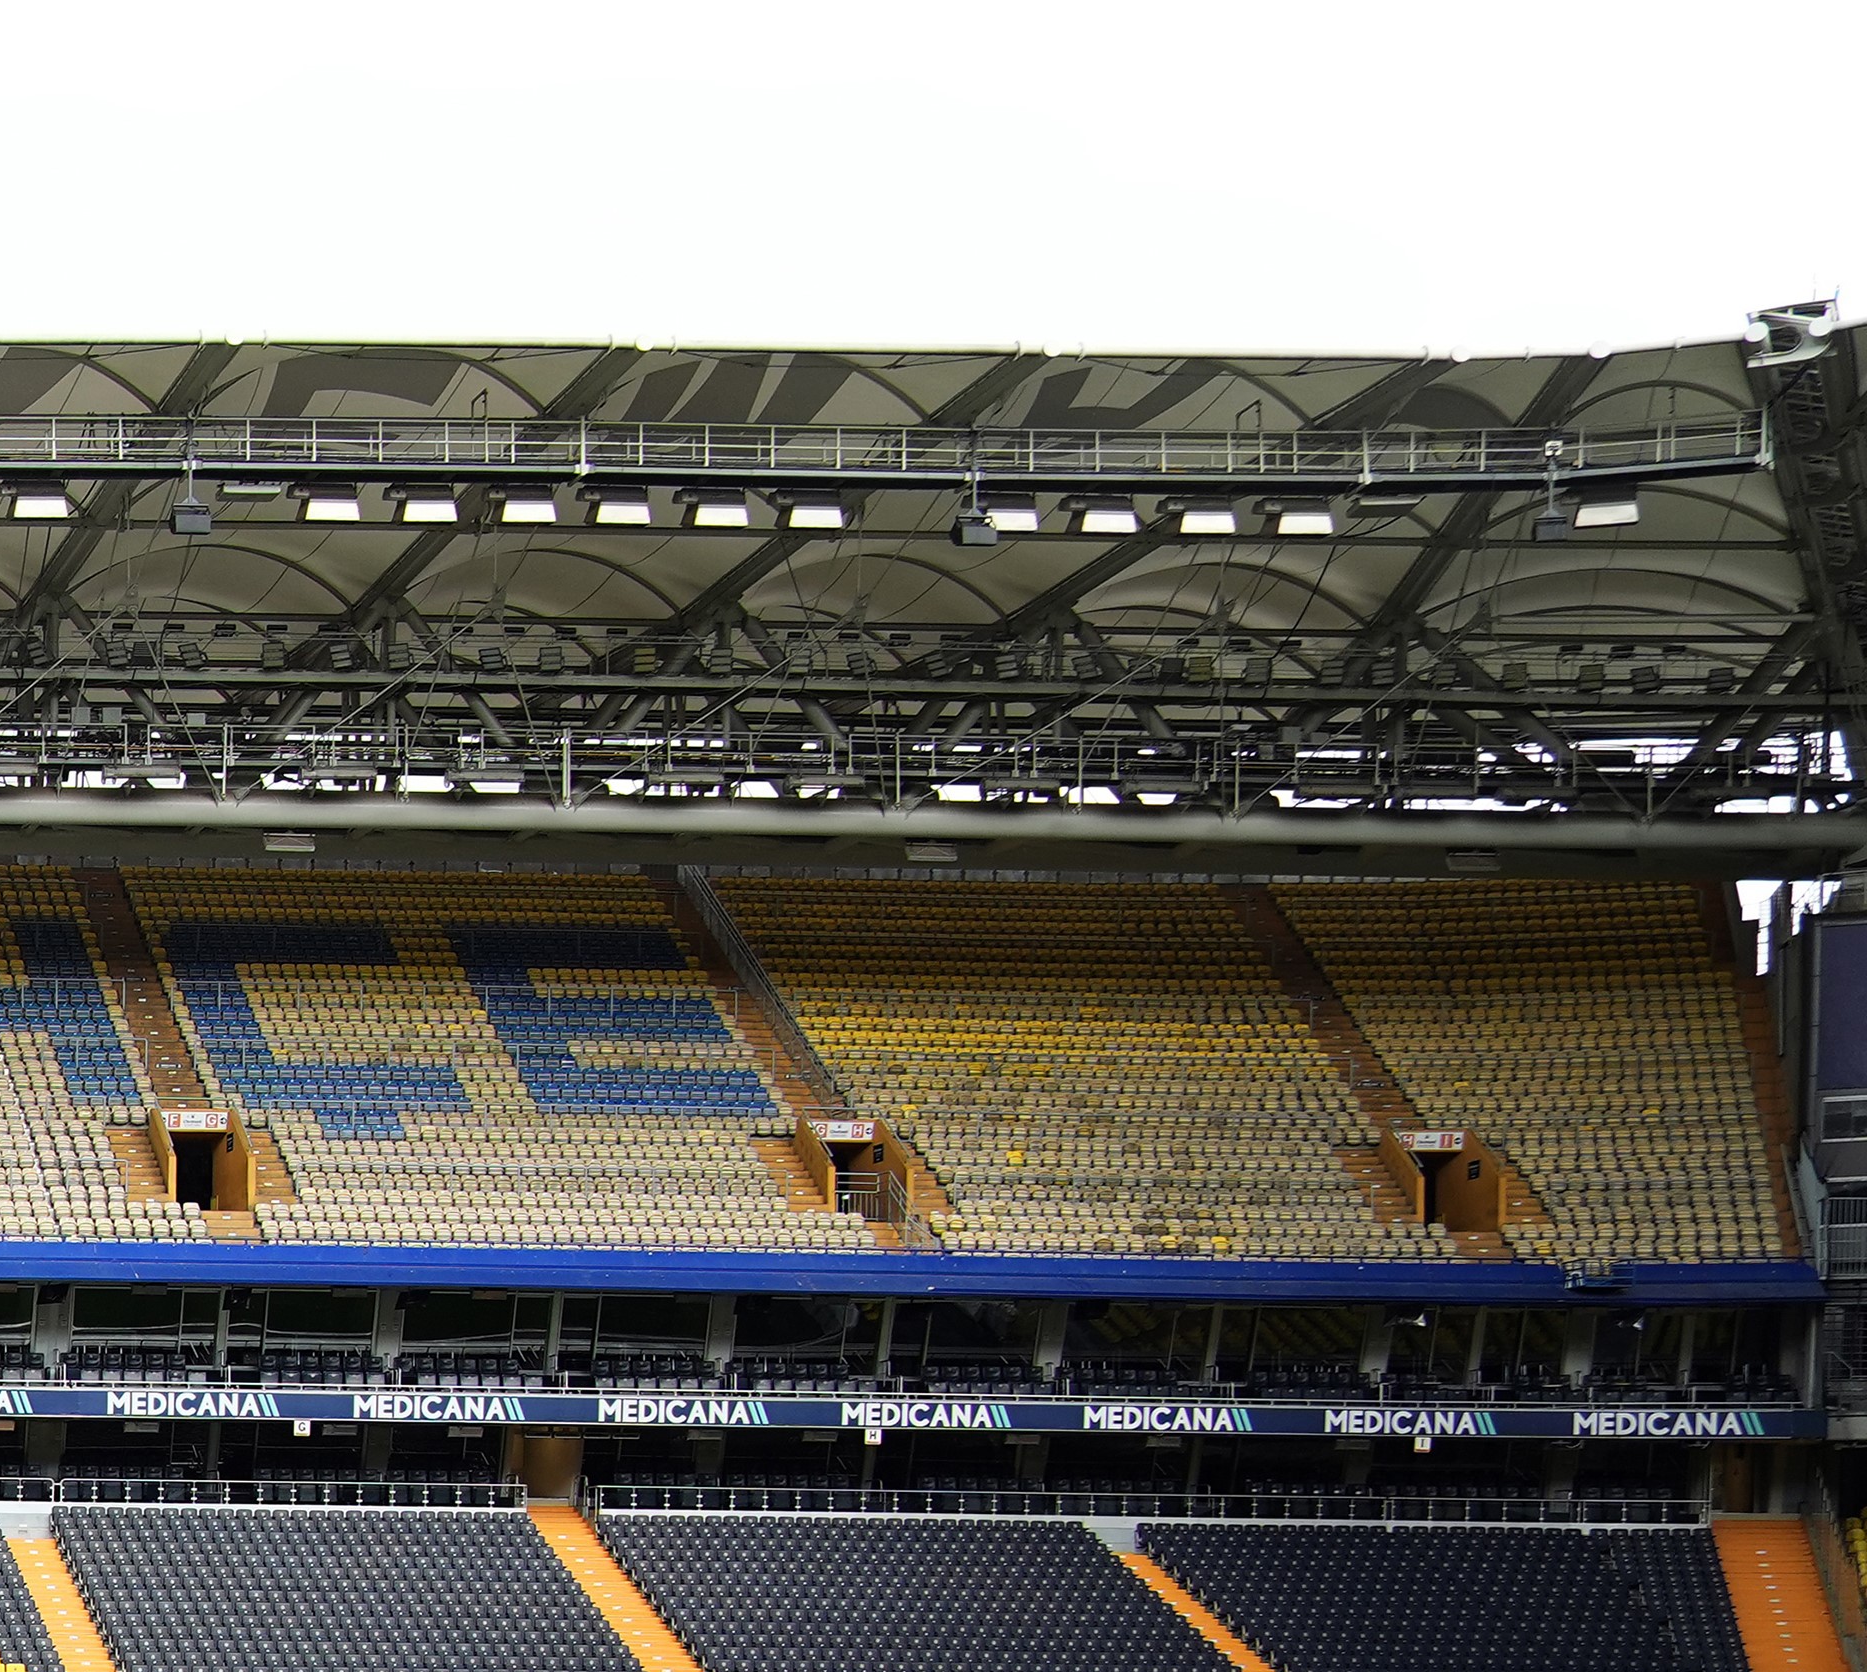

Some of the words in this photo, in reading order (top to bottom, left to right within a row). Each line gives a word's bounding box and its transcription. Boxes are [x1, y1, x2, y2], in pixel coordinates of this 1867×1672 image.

[106, 1392, 261, 1416] MEDICANA
[352, 1395, 507, 1420] MEDICANA
[598, 1400, 749, 1424] MEDICANA
[841, 1403, 994, 1428] MEDICANA
[1082, 1406, 1234, 1431] MEDICANA
[1324, 1410, 1475, 1434] MEDICANA
[1573, 1413, 1743, 1436] MEDICANA
